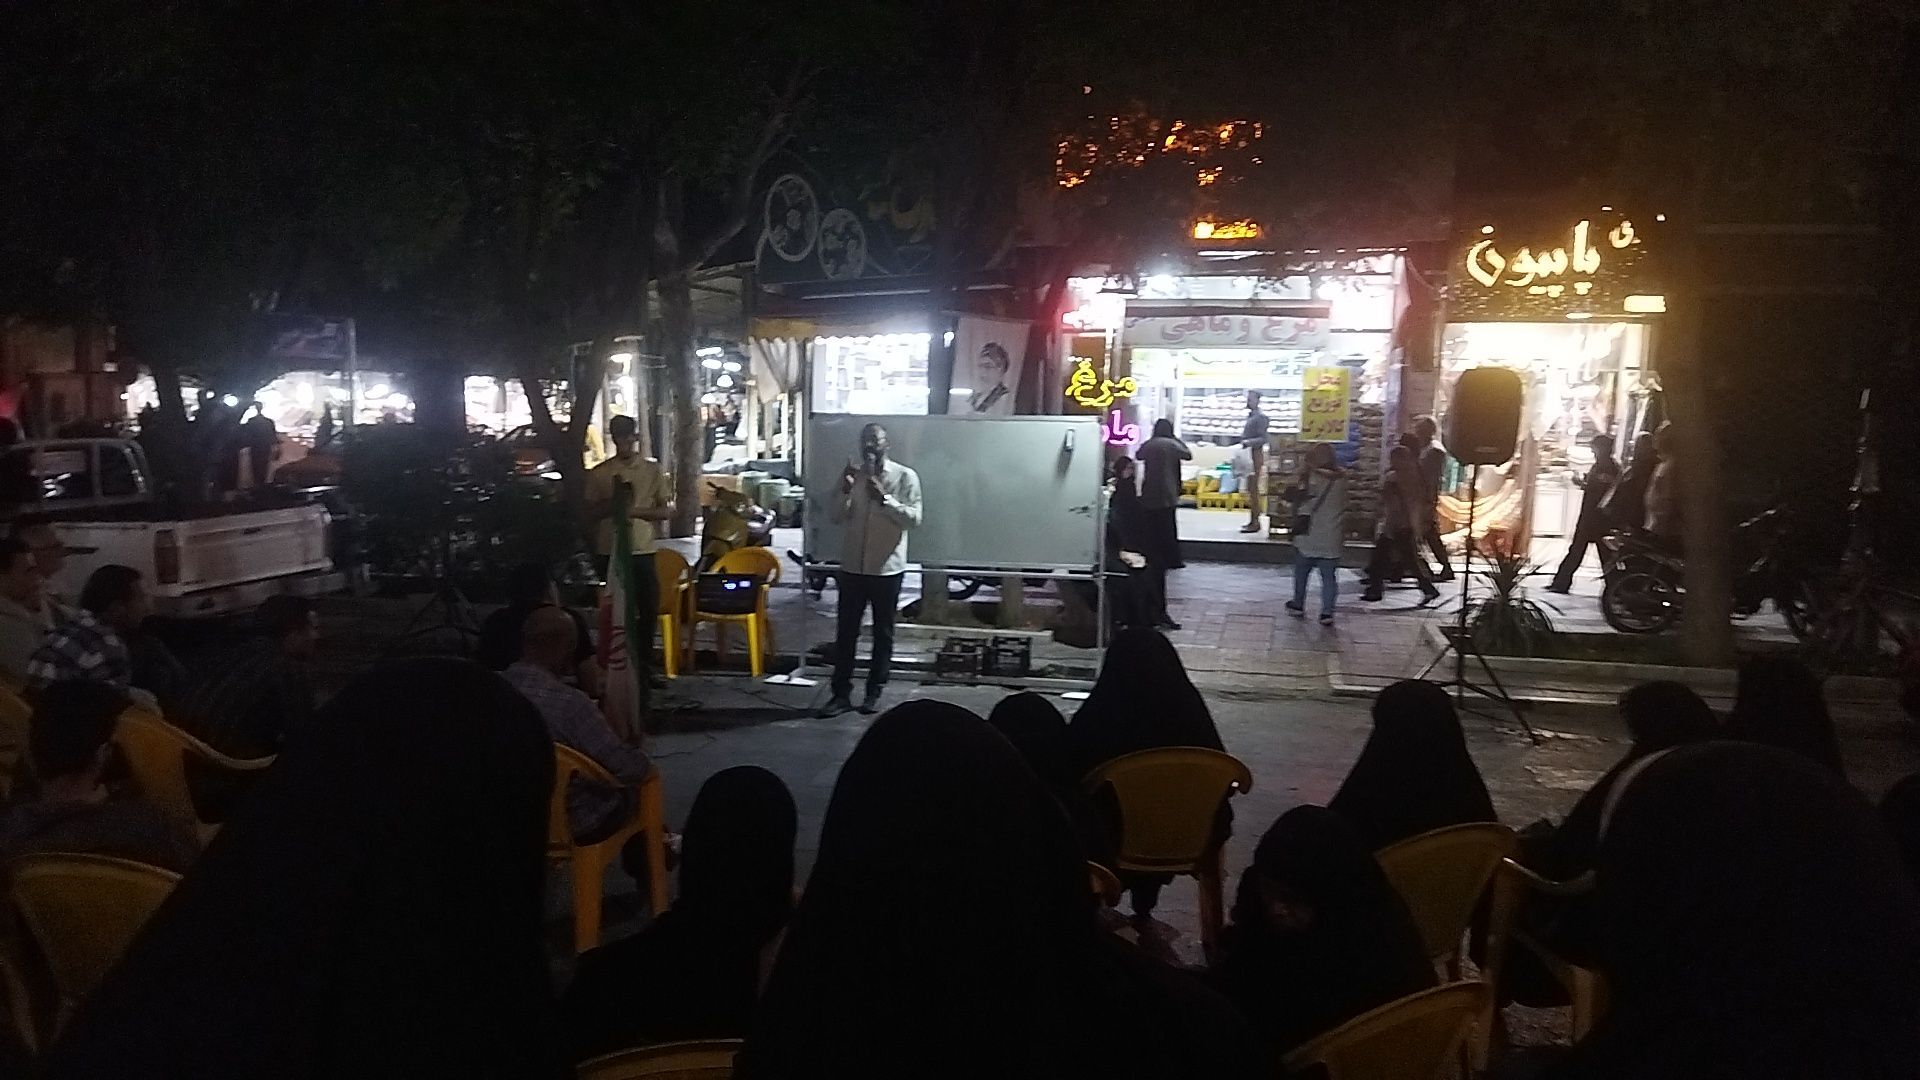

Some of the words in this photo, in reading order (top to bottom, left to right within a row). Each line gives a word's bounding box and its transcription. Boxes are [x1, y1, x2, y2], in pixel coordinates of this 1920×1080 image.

[1467, 220, 1600, 297] پاپیون
[1161, 316, 1231, 340] ماهی
[1236, 317, 1250, 342] و
[1065, 359, 1137, 407] مرغ
